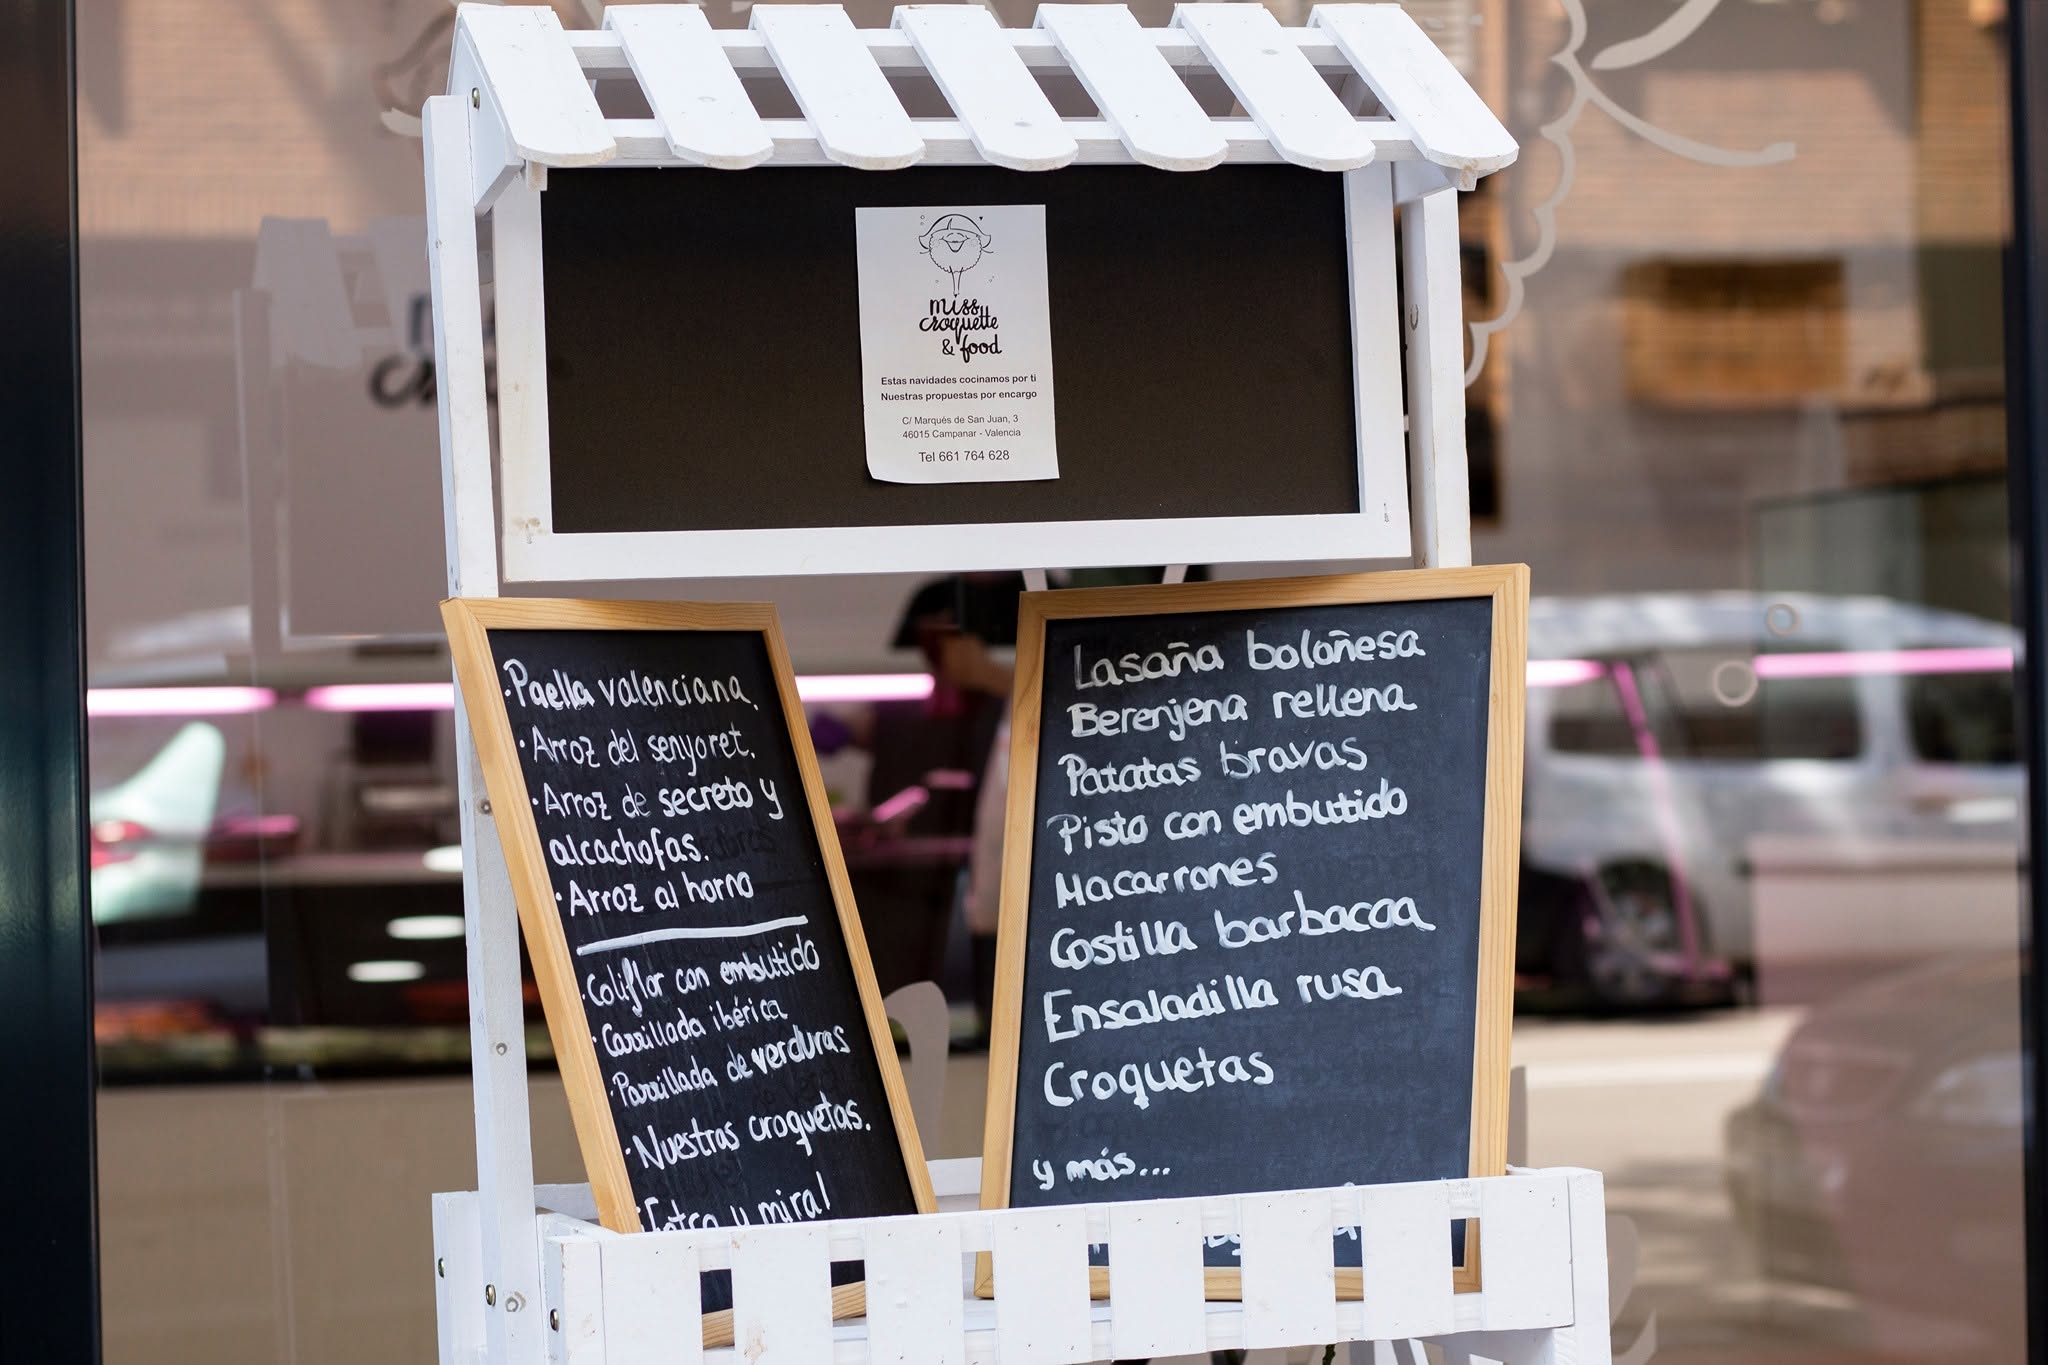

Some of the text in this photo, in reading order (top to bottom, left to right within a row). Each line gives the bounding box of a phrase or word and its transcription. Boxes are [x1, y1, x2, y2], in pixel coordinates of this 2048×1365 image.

[919, 306, 998, 345] croquette
[930, 298, 979, 316] miss
[941, 334, 1002, 363] & food
[880, 373, 1037, 386] Estas navidades cocinamos por ti
[880, 389, 1037, 402] Nuestras propuestas por encargo
[901, 413, 1019, 426] C/ Marqués de San Juan, 3
[902, 430, 930, 439] 46015
[932, 429, 977, 440] Campanar
[984, 428, 1022, 438] Valencia
[919, 450, 1010, 463] Tel 661 764 628
[1076, 642, 1224, 690] Lasaña
[1067, 684, 1417, 741] Berenjena rellena
[532, 725, 600, 768] Arroz
[608, 729, 639, 765] del
[1058, 737, 1367, 796] Patatas bravas
[544, 776, 783, 820] Arroz de secreto y
[1047, 777, 1407, 855] Pisto con embutido
[570, 871, 753, 916] Arroz al horno
[1056, 852, 1278, 908] Macarrones
[1050, 890, 1436, 970] Costilla barbacoa
[587, 934, 819, 1017] Coliflor con embutido
[709, 996, 788, 1031] ibérica
[1044, 966, 1402, 1043] Ensaladilla rusa
[727, 1045, 753, 1082] de
[751, 1024, 850, 1074] verduras
[1044, 1047, 1274, 1110] Croquetas
[632, 1117, 740, 1170] Nuestras
[1033, 1160, 1054, 1190] y
